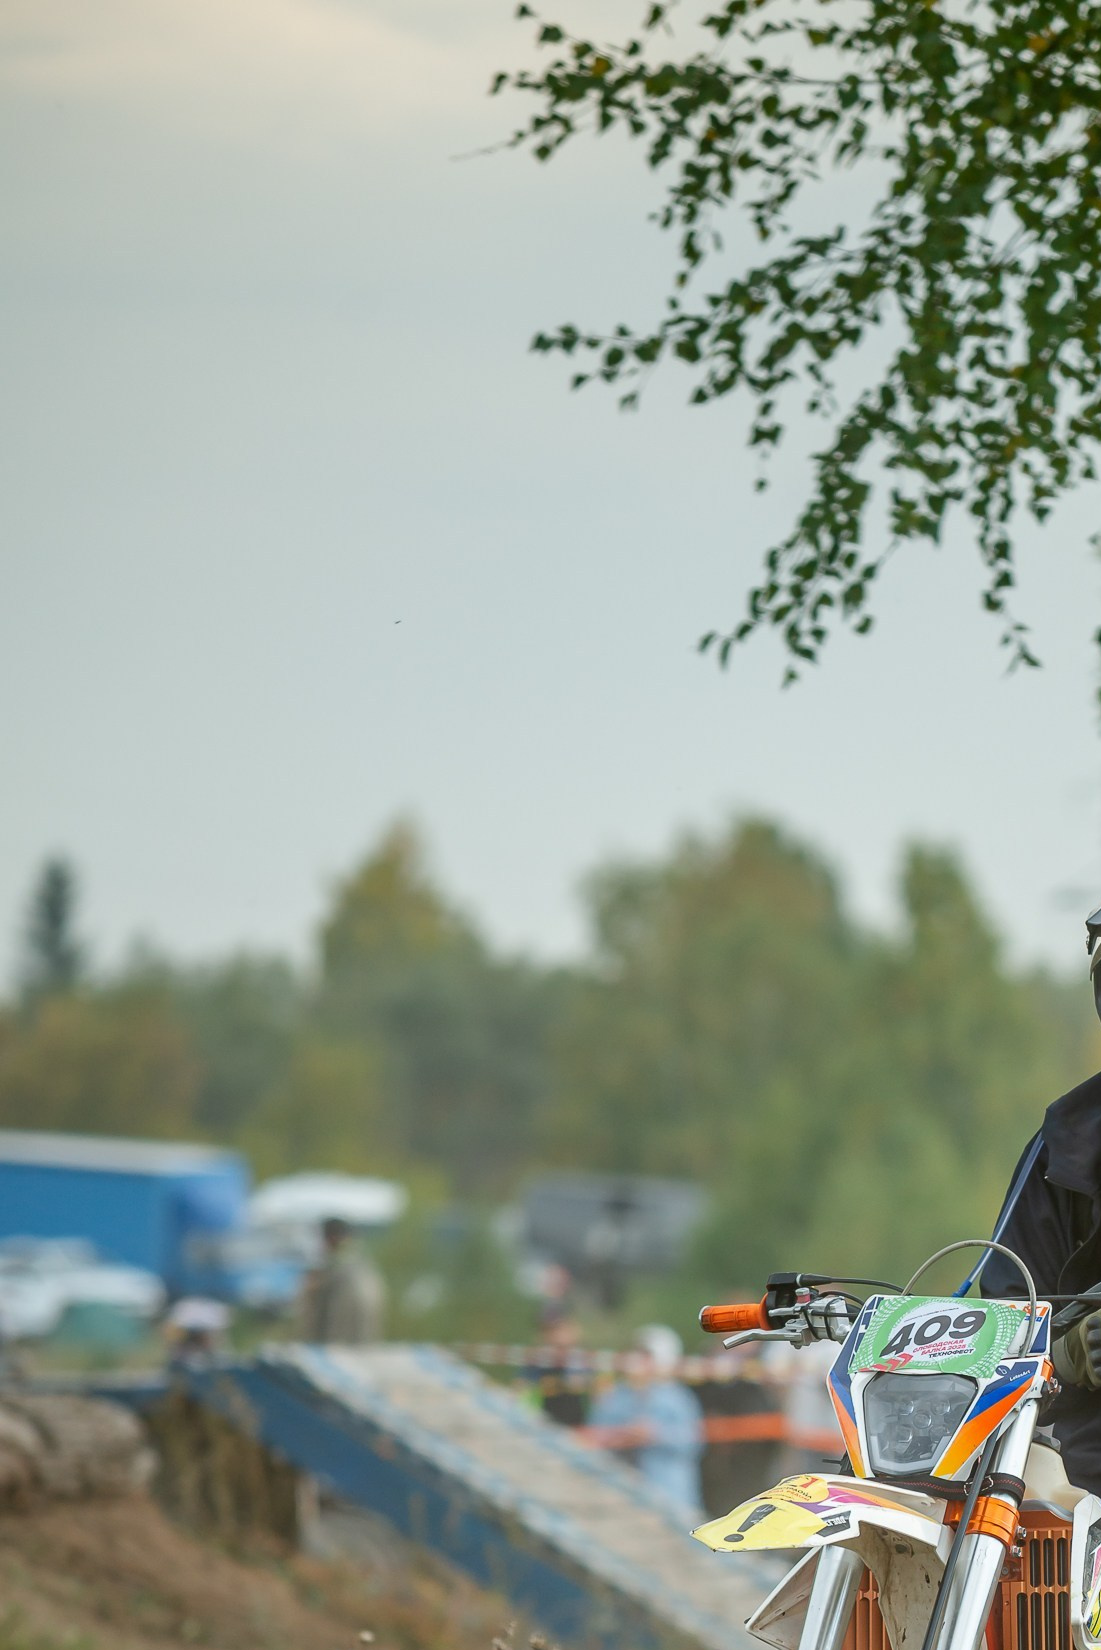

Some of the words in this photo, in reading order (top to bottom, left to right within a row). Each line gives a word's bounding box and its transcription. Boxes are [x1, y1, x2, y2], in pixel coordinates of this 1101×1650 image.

[878, 1310, 986, 1358] 409
[913, 1339, 964, 1353] СЛОБОДСКАЯ
[921, 1346, 946, 1356] БАЛКА
[929, 1348, 974, 1358] ТЕХНОФЕСТ
